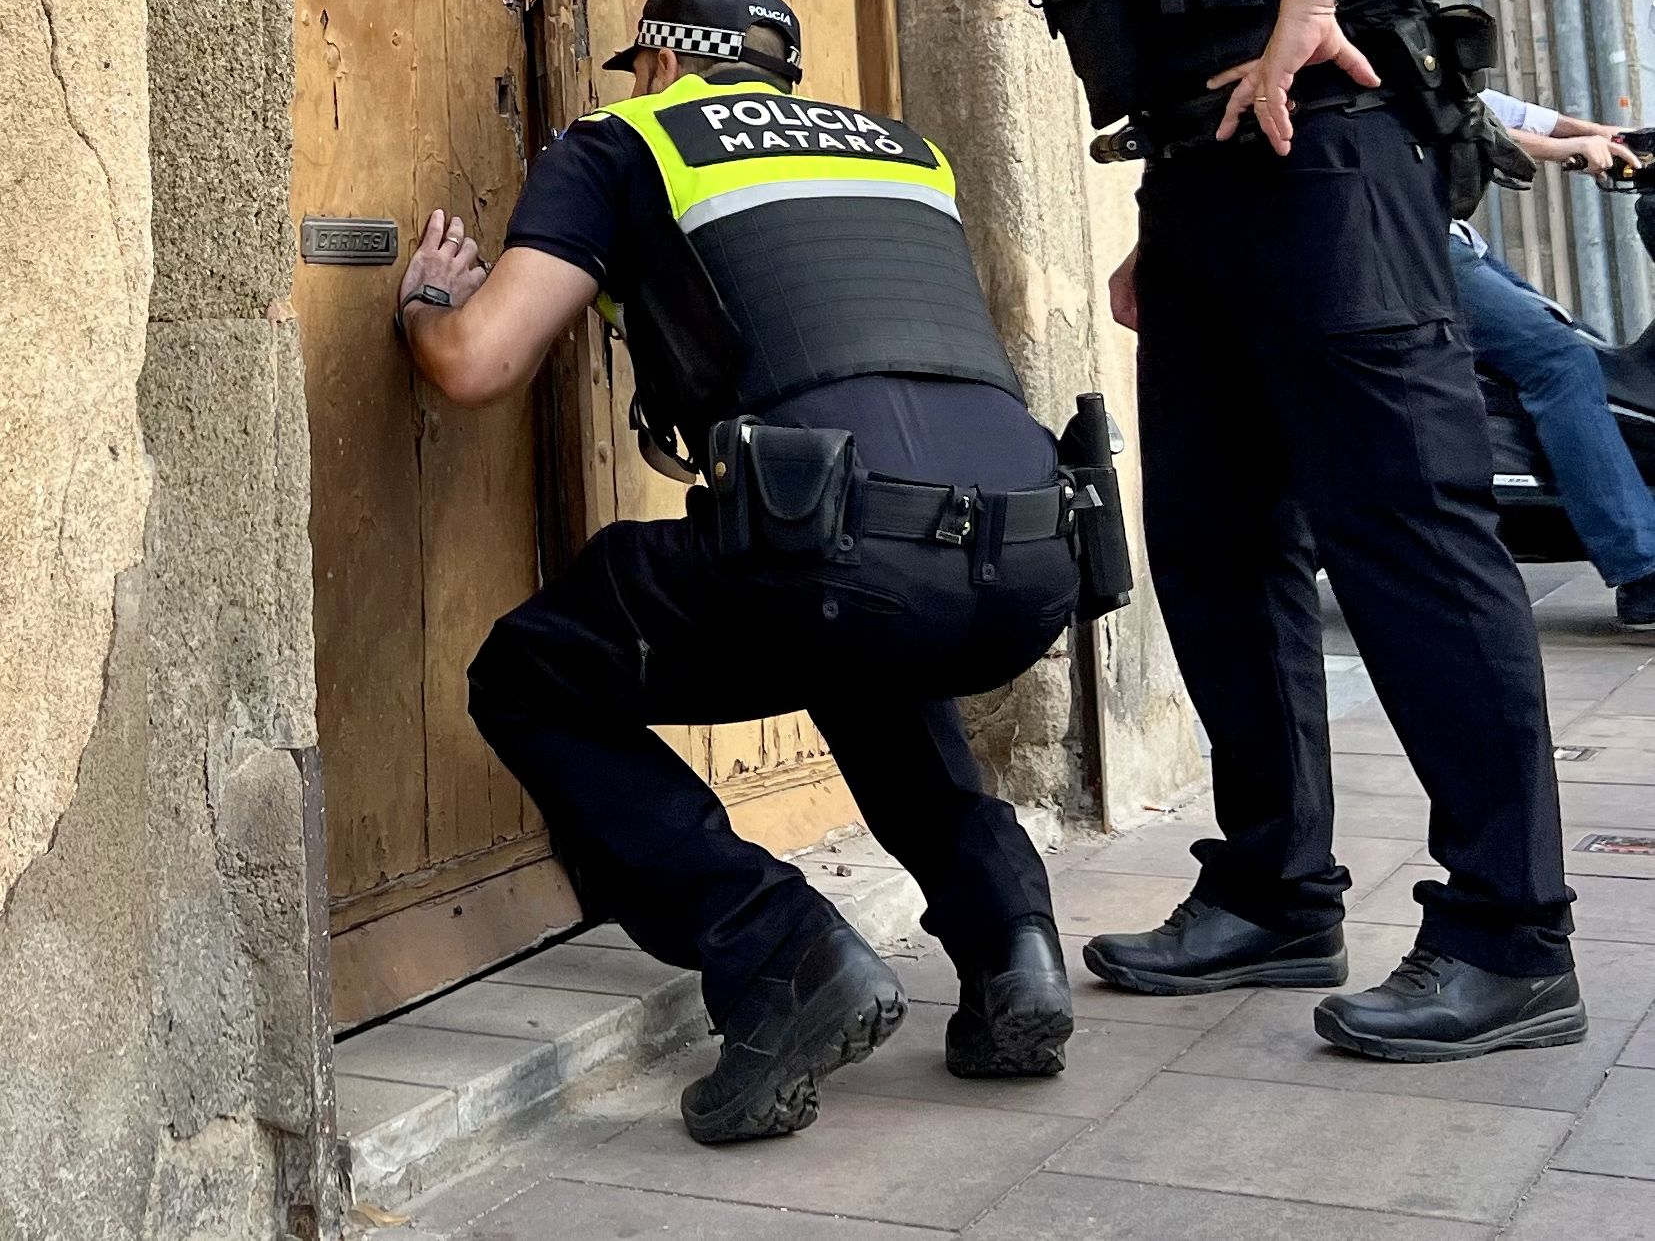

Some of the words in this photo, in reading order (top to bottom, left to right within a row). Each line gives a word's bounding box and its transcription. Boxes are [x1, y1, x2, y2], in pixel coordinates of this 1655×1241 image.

[700, 100, 890, 136] POLICIA
[719, 130, 904, 155] MATARÓ
[317, 230, 383, 251] CARTAS
